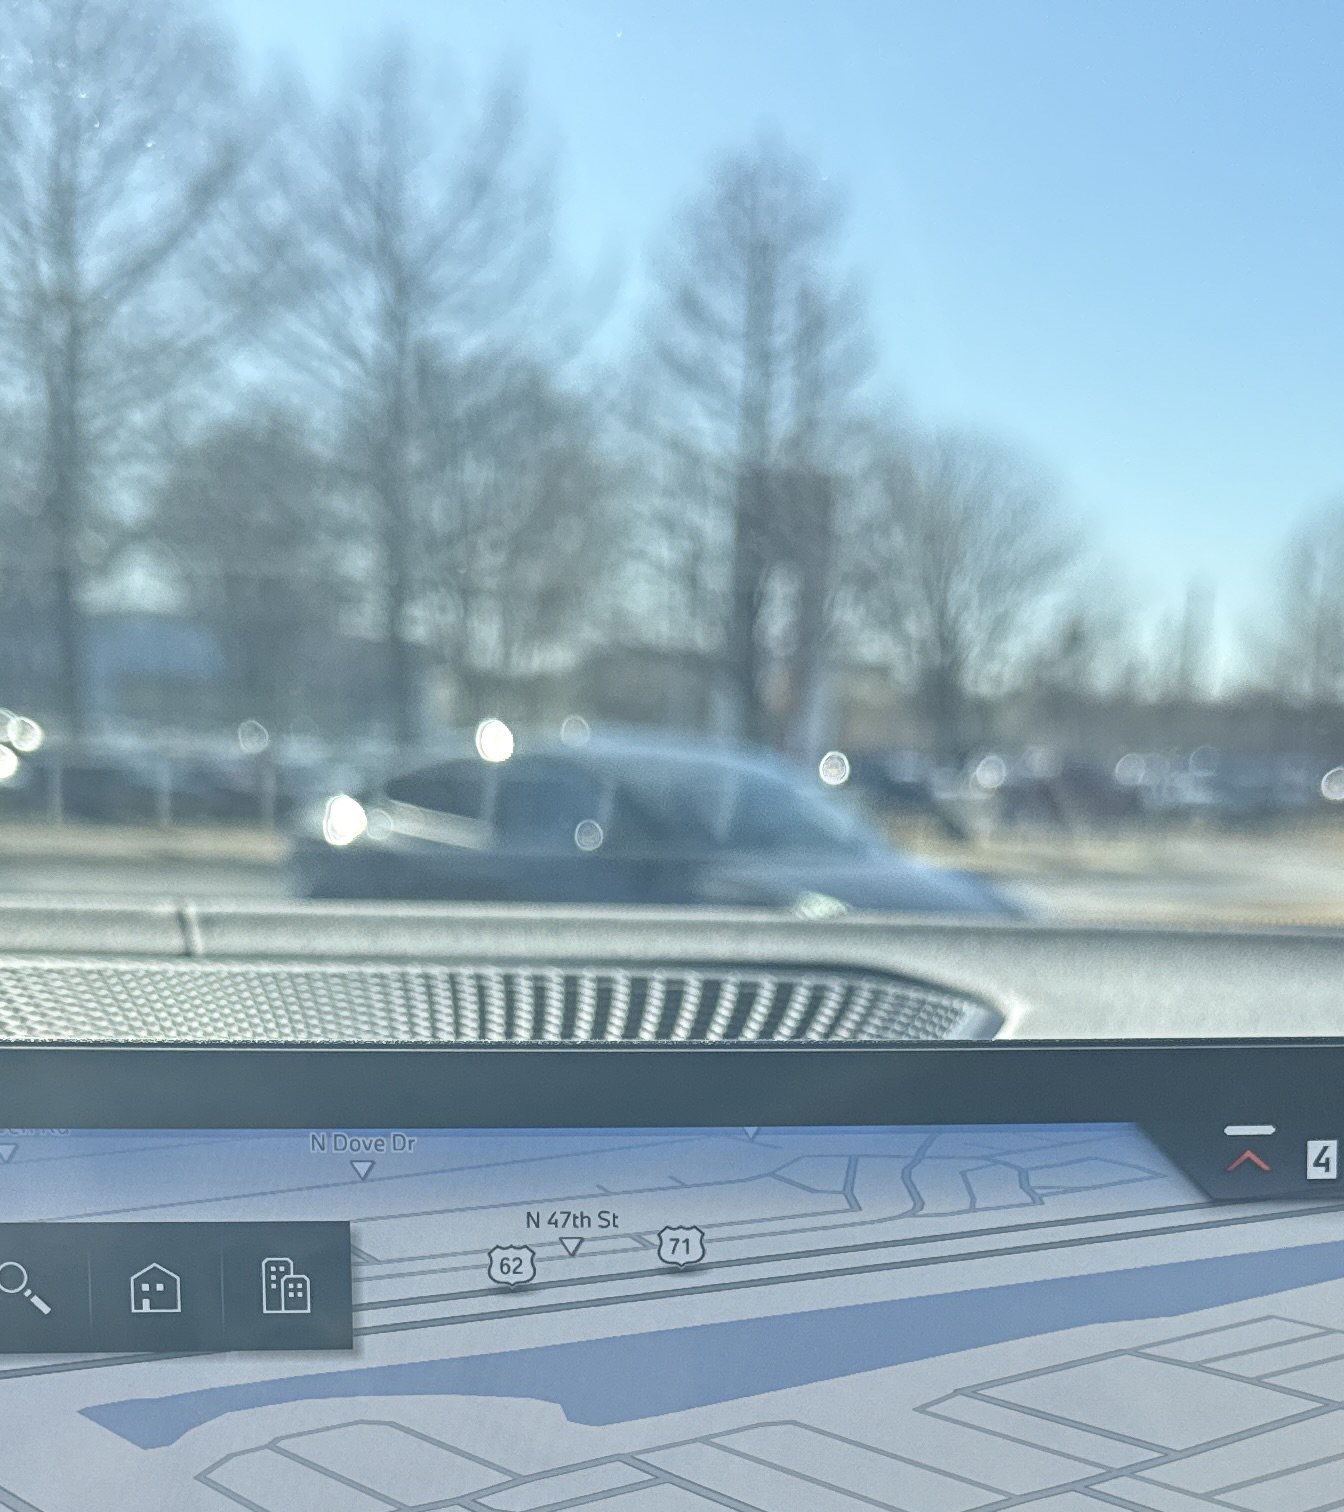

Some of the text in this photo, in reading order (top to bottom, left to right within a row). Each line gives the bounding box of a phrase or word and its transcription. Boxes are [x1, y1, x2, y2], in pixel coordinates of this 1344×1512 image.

[310, 1133, 416, 1153] N Dove Dr
[1312, 1145, 1331, 1173] 4
[526, 1210, 619, 1229] N 47th St
[669, 1238, 691, 1256] 71
[498, 1257, 524, 1276] 62
